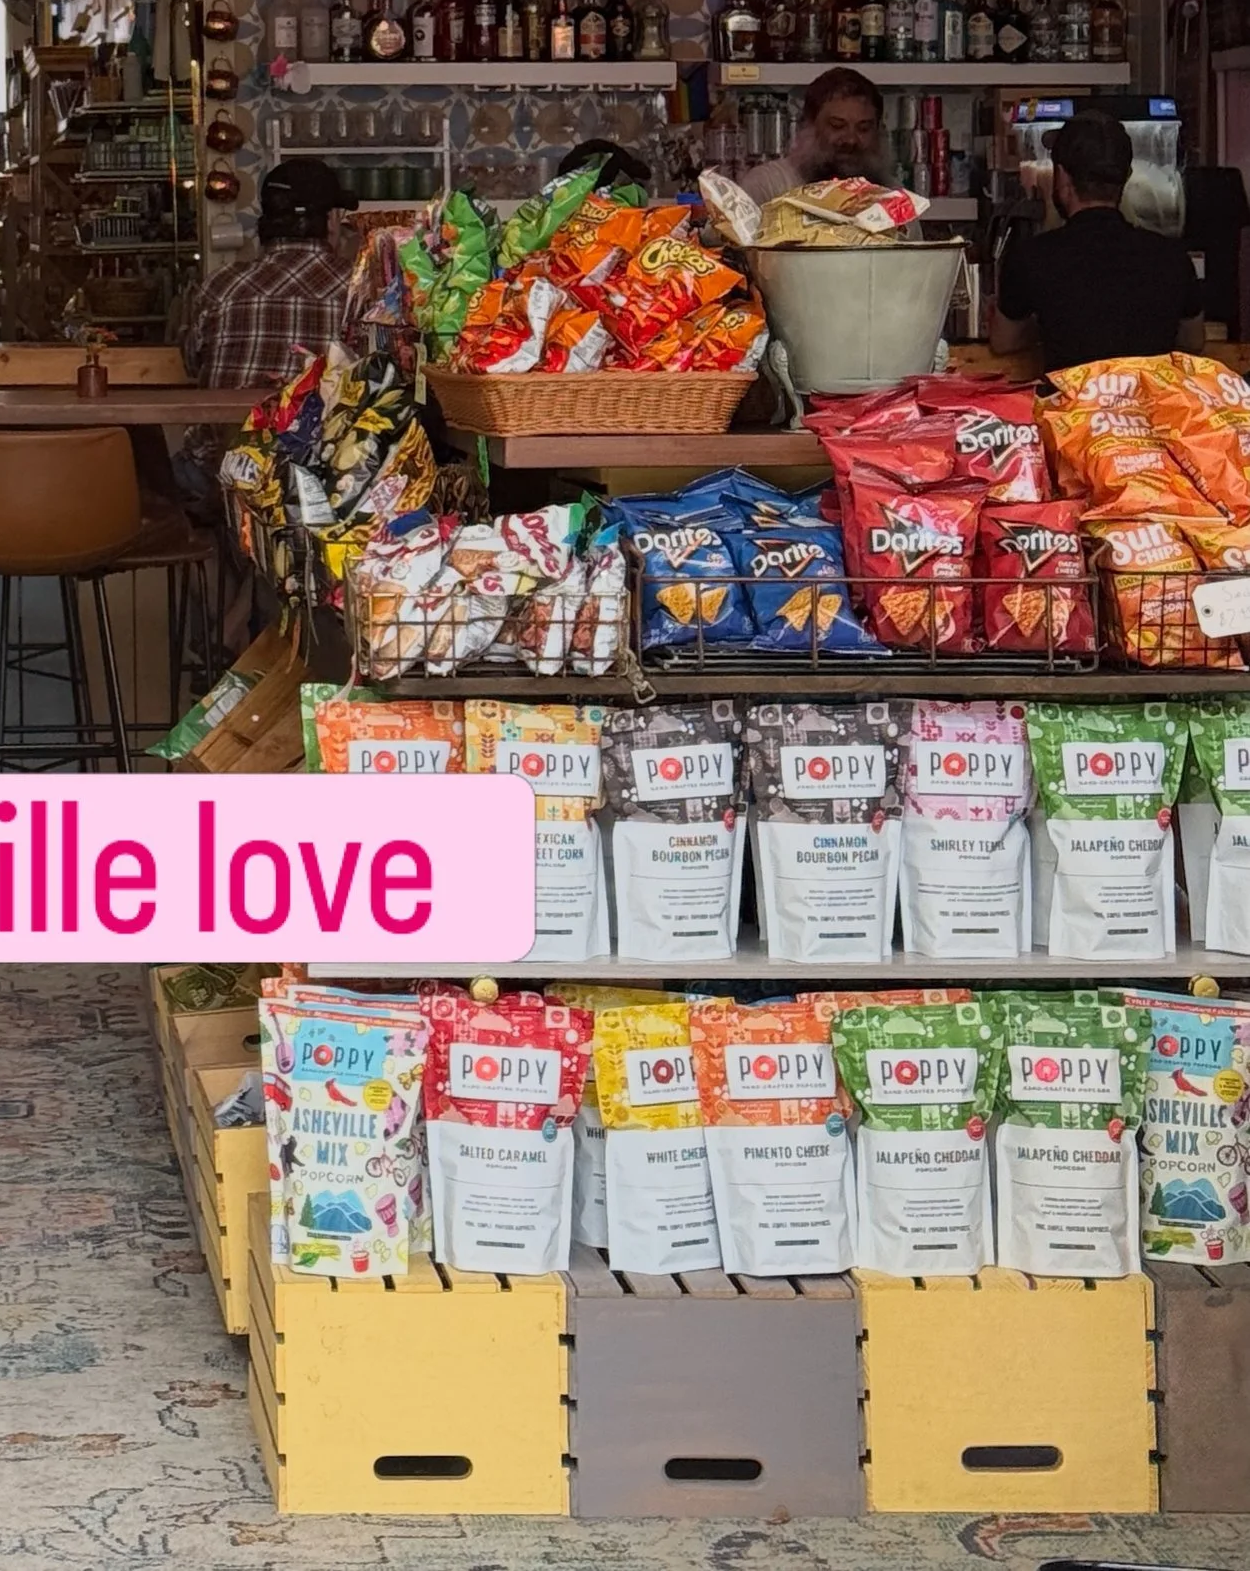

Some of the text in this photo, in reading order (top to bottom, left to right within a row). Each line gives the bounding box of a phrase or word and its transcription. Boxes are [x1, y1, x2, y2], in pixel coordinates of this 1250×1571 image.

[956, 423, 1040, 454] Doritos
[1112, 425, 1151, 437] CHIP
[633, 527, 723, 554] Doritos
[871, 529, 964, 554] Doritos
[1105, 522, 1173, 566] Sun
[750, 541, 833, 578] Dorito
[1135, 543, 1183, 567] CHIPS
[360, 749, 440, 774] POPPY
[509, 751, 591, 779] POPPY
[646, 753, 723, 783] POPPY
[795, 755, 875, 781] POPPY
[930, 752, 1012, 779] POPPY
[1076, 752, 1156, 777] POPPY
[535, 832, 576, 845] EXICAN
[668, 835, 719, 848] CINNAMON
[813, 836, 868, 848] CINNAMON
[930, 838, 975, 852] SHIRLEY
[1070, 836, 1125, 852] JALAPEÑO
[535, 848, 585, 860] EET CORN
[651, 849, 702, 863] BOURBON
[796, 849, 879, 864] BOURBON PECAN
[302, 1042, 375, 1072] POPPY
[738, 1053, 824, 1082] POPPY
[462, 1054, 548, 1086] POPPY
[880, 1058, 966, 1086] POPPY
[1021, 1056, 1109, 1085] POPPY
[292, 1107, 378, 1139] ASHEVILLE
[1148, 1098, 1228, 1128] SHEVILLE
[585, 1126, 605, 1139] WHI
[1165, 1129, 1200, 1156] MIX
[316, 1140, 349, 1167] MIX
[460, 1144, 548, 1163] SALTED CARAMEL
[646, 1149, 679, 1164] WHITE
[744, 1144, 831, 1160] PIMENTO CHEESE
[876, 1148, 981, 1164] JALAPEÑO CHEDDAR
[1017, 1145, 1122, 1163] JALAPEÑO CHEDDAR
[300, 1169, 365, 1184] POPCORN
[1149, 1158, 1216, 1173] POPCORN
